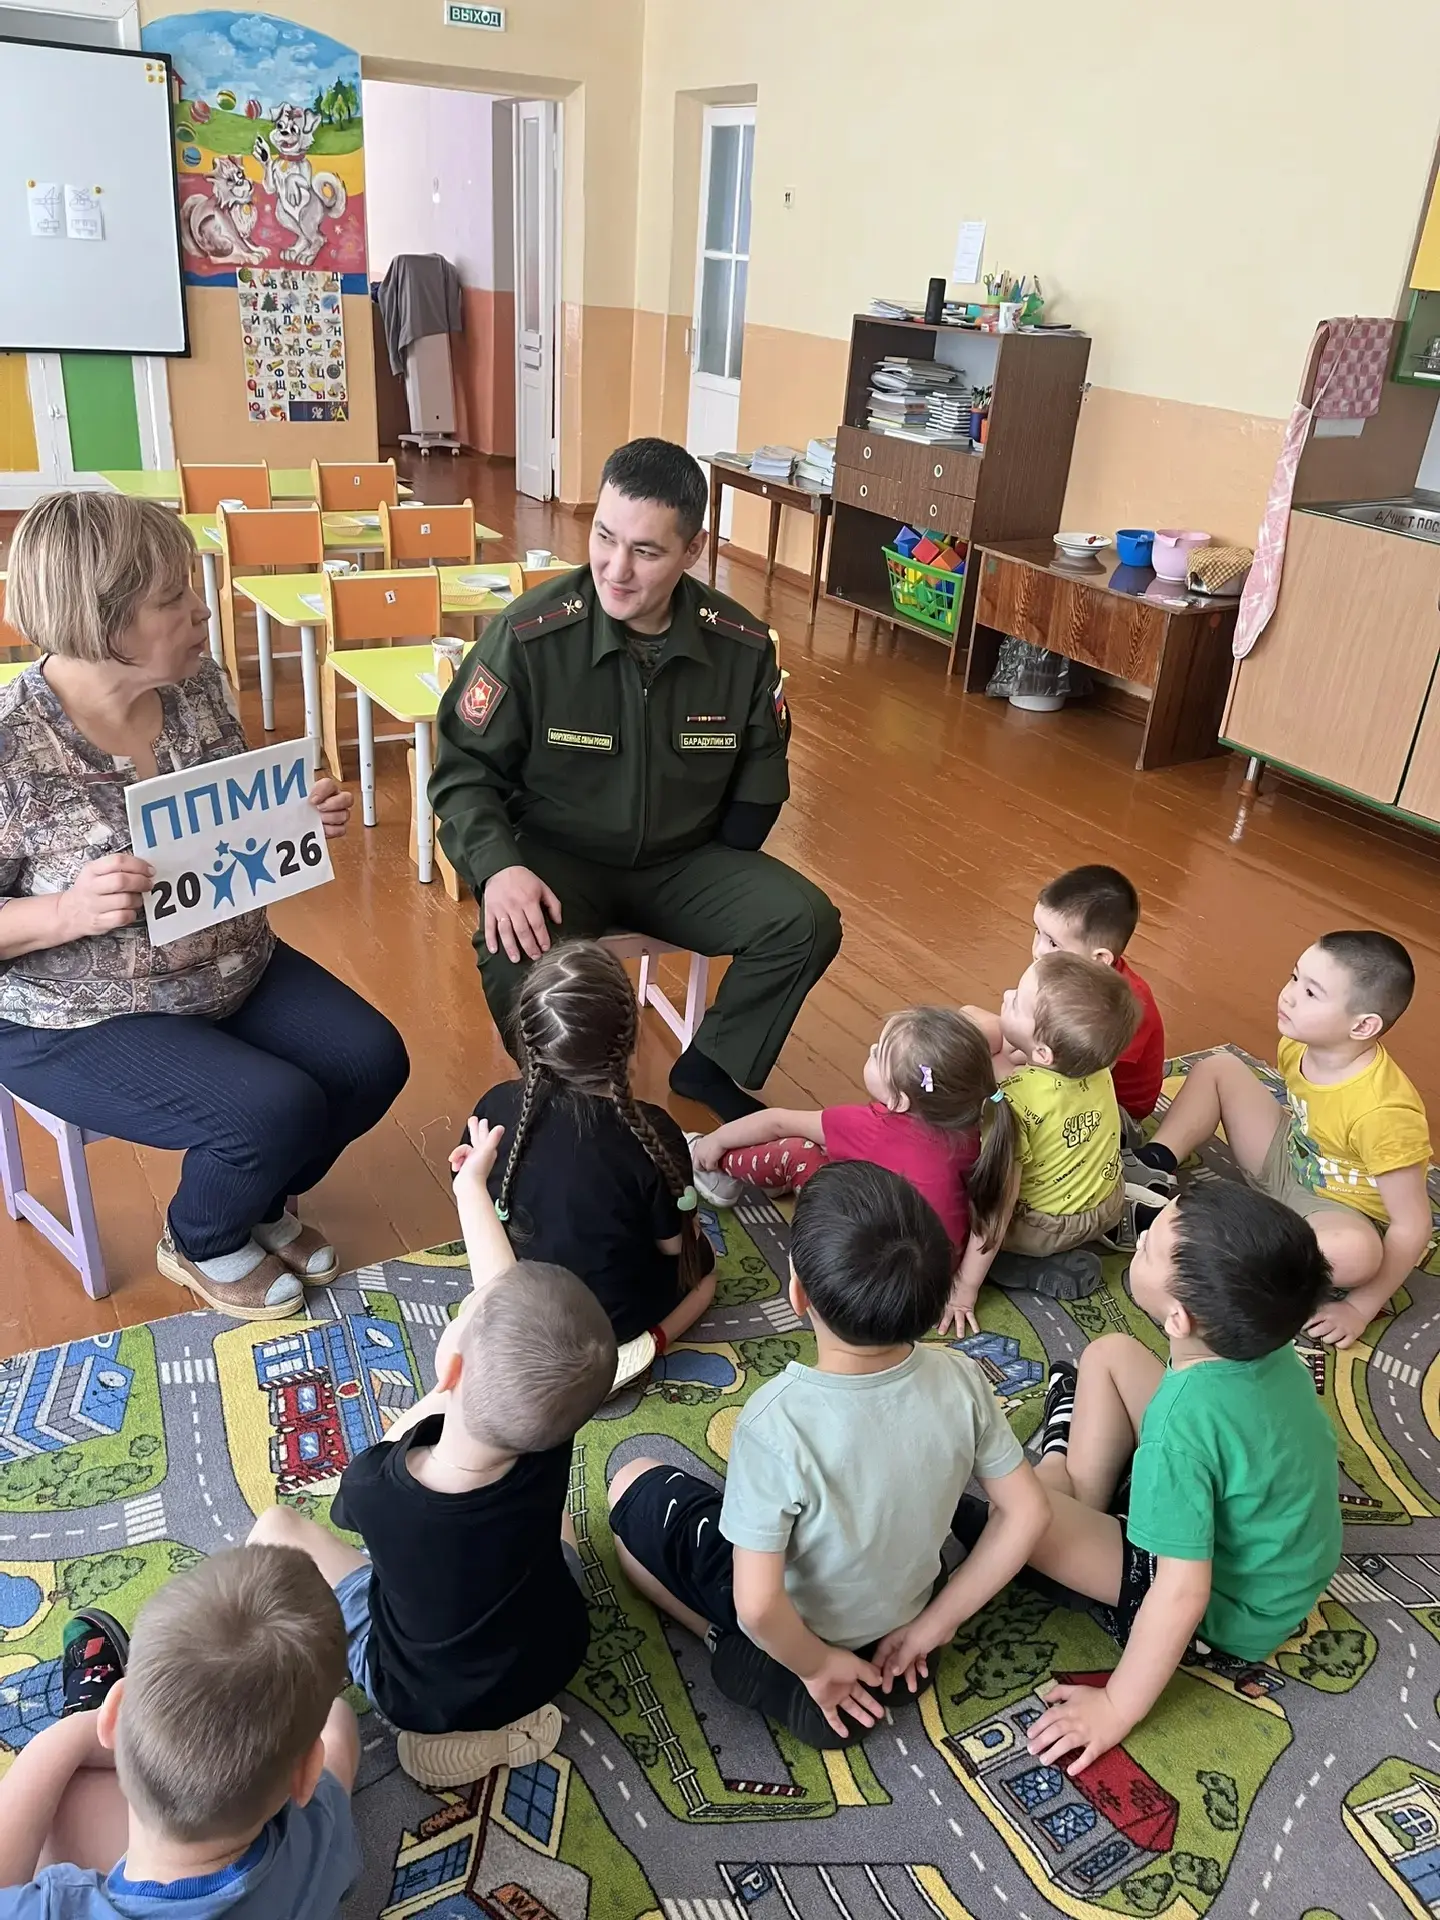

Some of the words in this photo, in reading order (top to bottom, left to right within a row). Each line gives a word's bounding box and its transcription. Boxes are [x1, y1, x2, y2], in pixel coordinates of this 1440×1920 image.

[452, 8, 499, 26] ВЫХОД
[249, 280, 257, 289] А
[270, 280, 277, 289] Б
[292, 280, 299, 290] В
[282, 304, 293, 313] Ж
[332, 305, 340, 314] И
[251, 313, 260, 325] Й
[275, 325, 282, 335] К
[304, 315, 314, 324] М
[334, 326, 341, 336] Н
[243, 335, 252, 345] О
[264, 336, 272, 346] П
[298, 348, 305, 357] Р
[306, 338, 313, 348] С
[325, 339, 332, 348] Т
[255, 359, 263, 369] У
[274, 368, 284, 377] Ф
[297, 369, 305, 378] Х
[317, 369, 325, 379] Ц
[337, 360, 344, 369] Ч
[255, 389, 264, 398] Ш
[276, 380, 286, 390] Щ
[316, 391, 325, 399] Ы
[248, 402, 260, 411] Ю
[280, 412, 287, 421] Я
[683, 737, 724, 747] БАРАДУЛИН
[141, 758, 308, 848] ППМИ
[150, 872, 201, 921] 20
[275, 831, 322, 877] 26
[1063, 1110, 1102, 1138] SUPER
